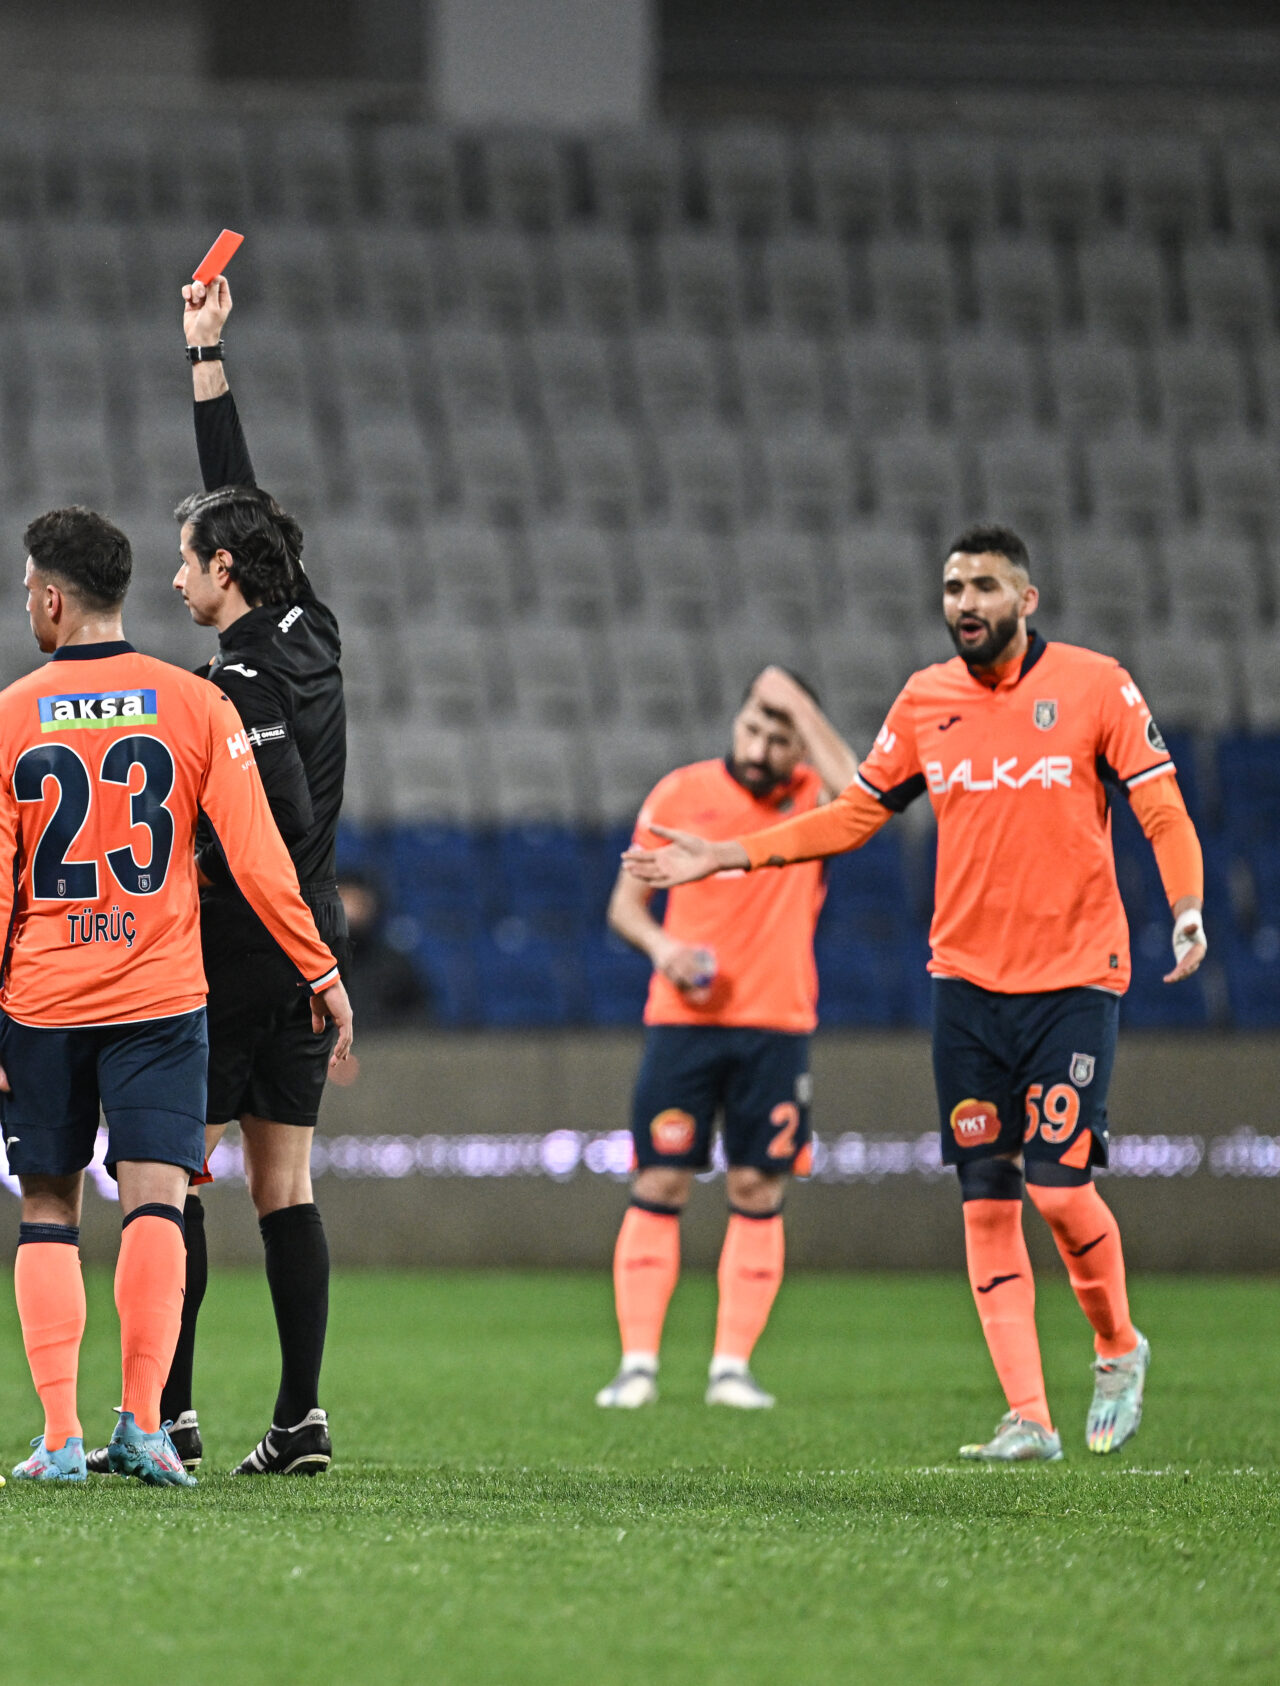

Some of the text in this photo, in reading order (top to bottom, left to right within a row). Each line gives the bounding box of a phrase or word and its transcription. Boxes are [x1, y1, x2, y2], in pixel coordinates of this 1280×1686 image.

[54, 695, 145, 722] aksa
[925, 756, 1073, 794] BALKAR
[12, 734, 176, 901] 23
[66, 904, 137, 949] TÜRÜÇ
[768, 1101, 800, 1159] 2
[957, 1114, 987, 1133] YKT
[1023, 1082, 1081, 1145] 59
